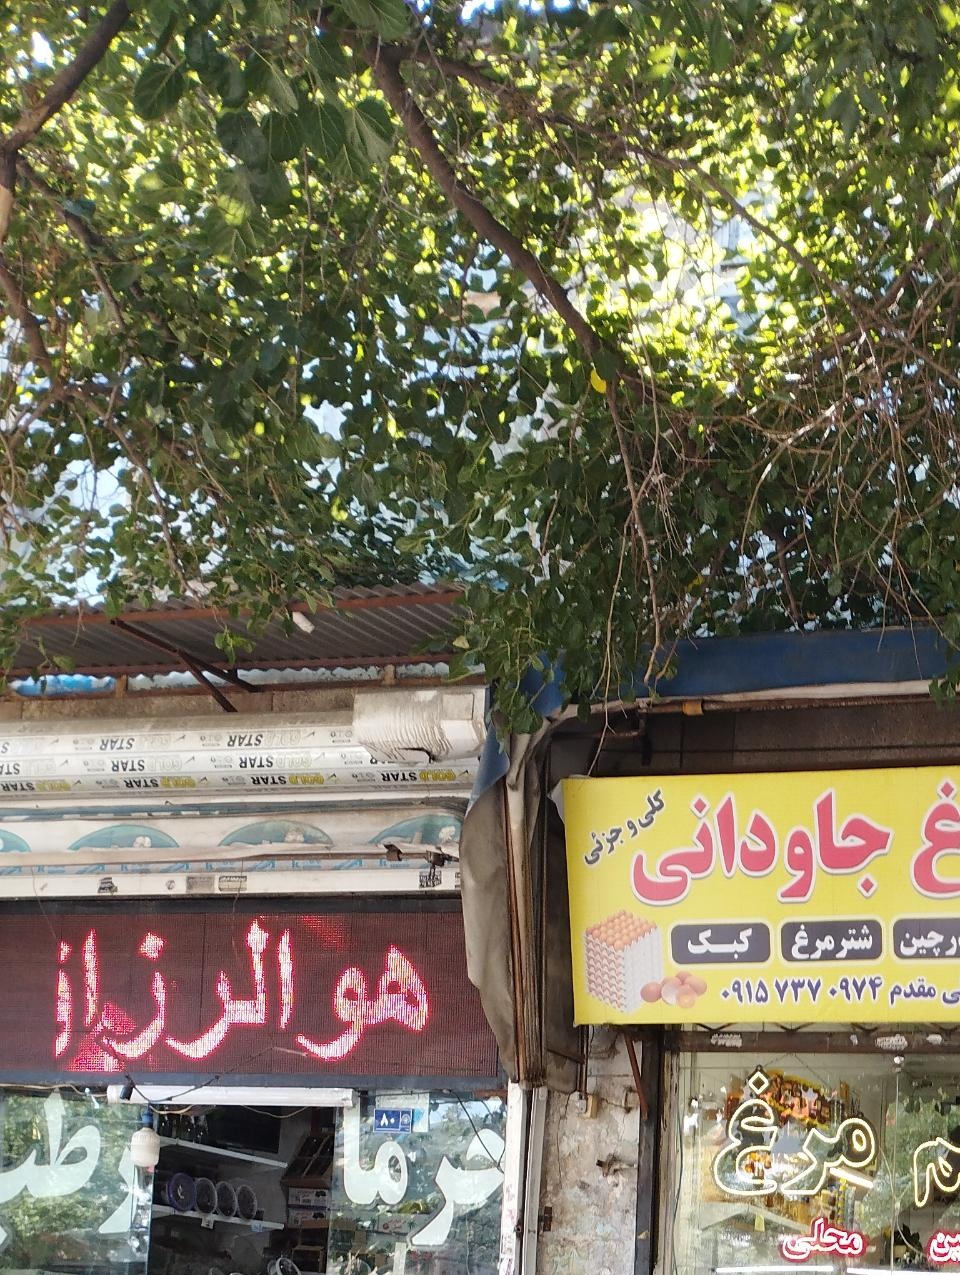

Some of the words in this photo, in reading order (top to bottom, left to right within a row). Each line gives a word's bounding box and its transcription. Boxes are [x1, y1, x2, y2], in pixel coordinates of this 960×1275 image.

[100, 738, 136, 751] STAR
[227, 734, 264, 747] STAR
[111, 759, 146, 773] STAR
[239, 756, 274, 769] STAR
[123, 778, 160, 789] STAR
[250, 776, 287, 786] STAR
[381, 772, 418, 783] STAR
[0, 782, 35, 792] STAR
[638, 789, 664, 828] کلی
[633, 792, 891, 902] جاودانی
[687, 927, 752, 959] کبک
[890, 978, 936, 1005] مقدم
[295, 944, 429, 1063] هو
[711, 1064, 876, 1197] مرغ
[782, 1217, 864, 1260] محلی
